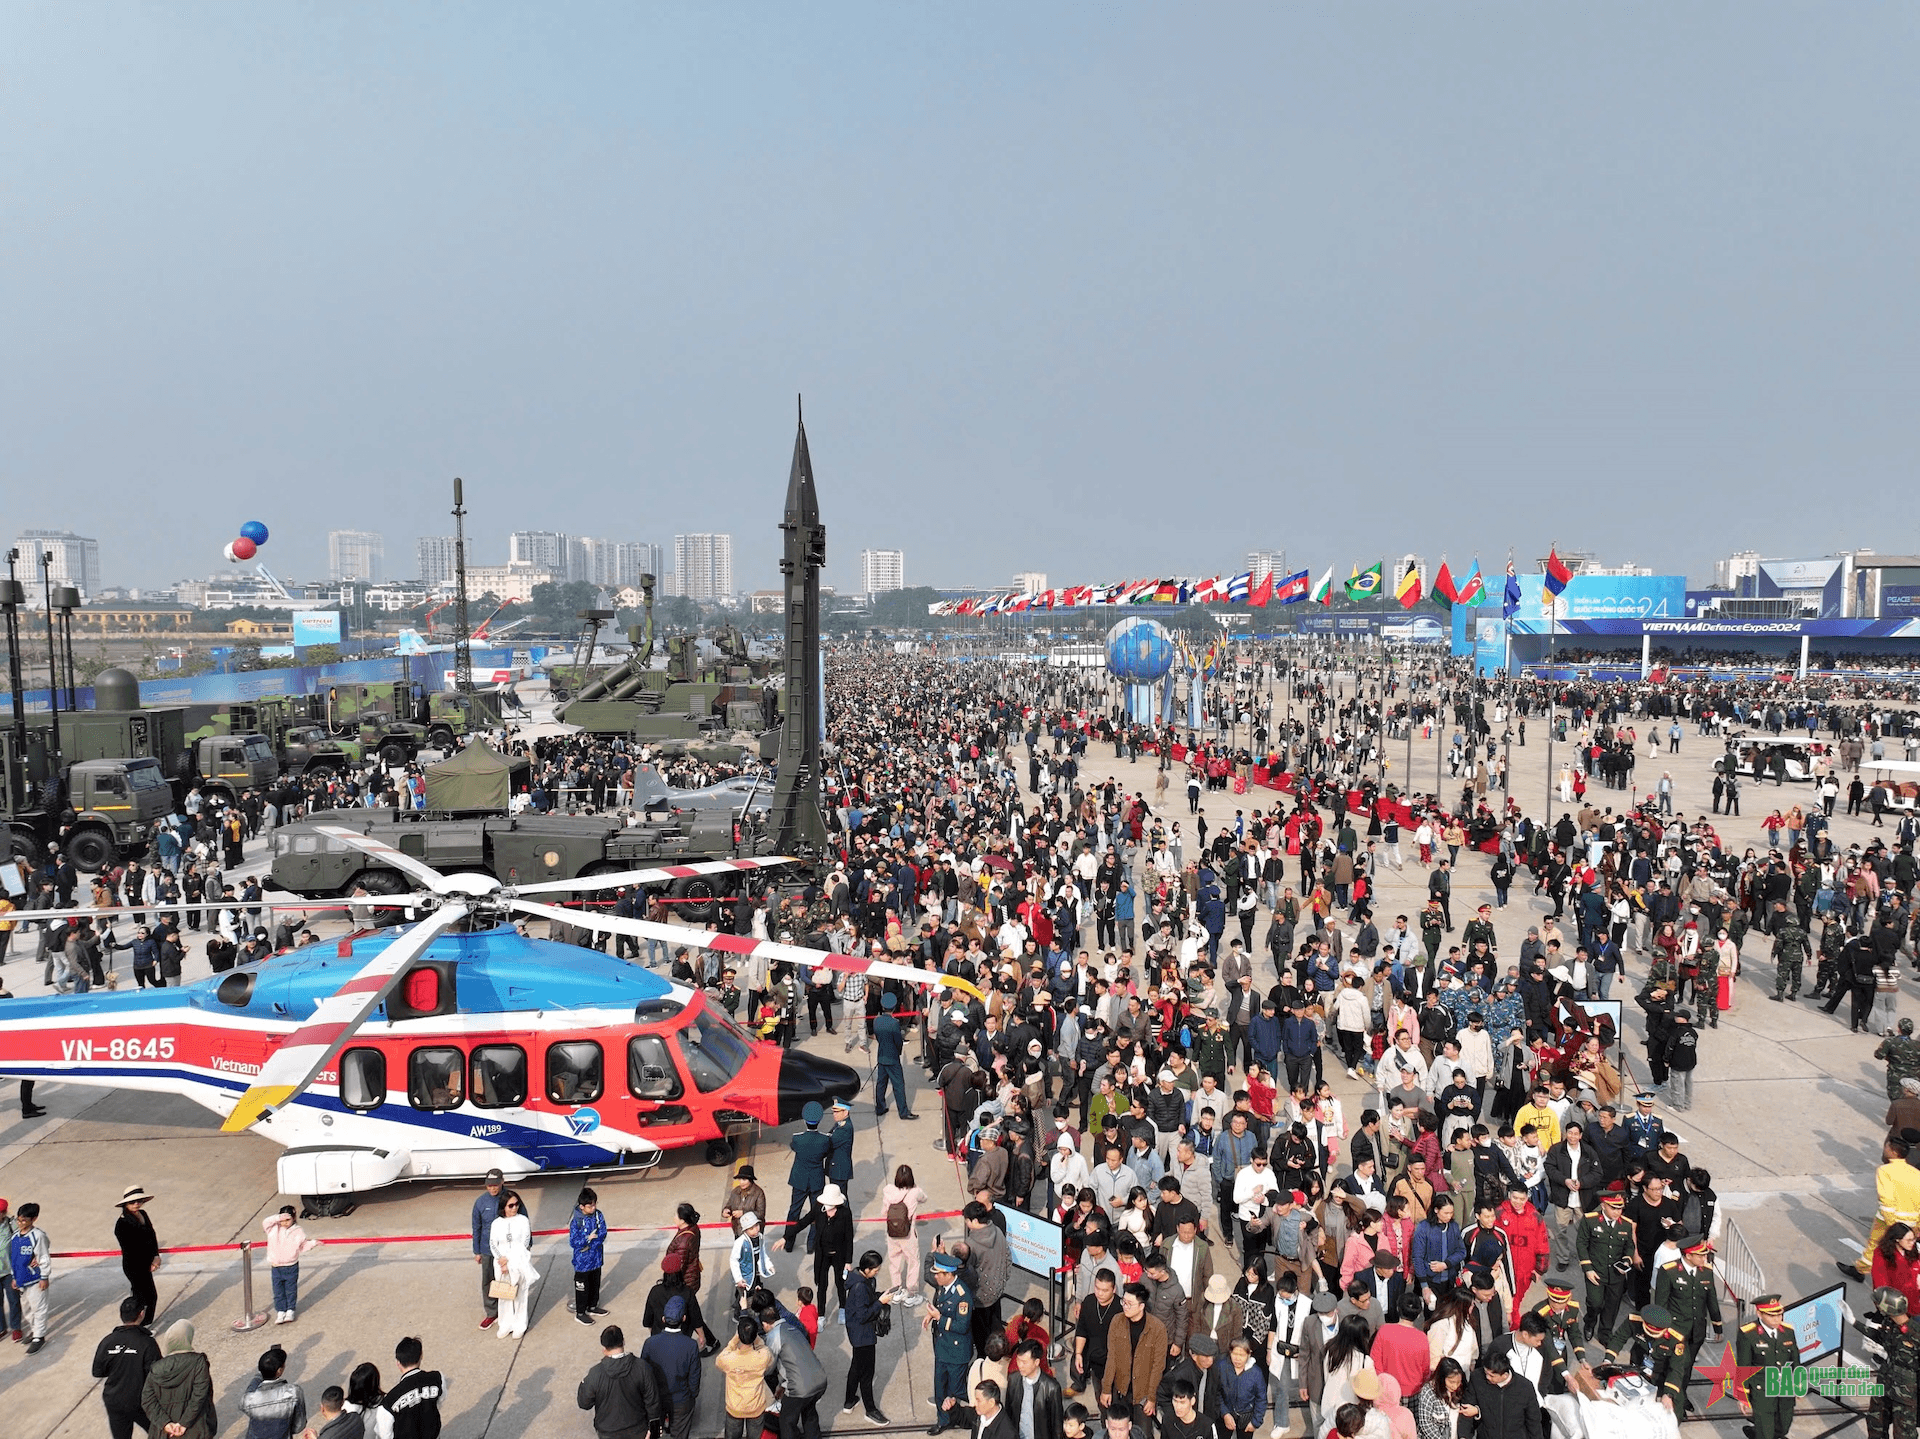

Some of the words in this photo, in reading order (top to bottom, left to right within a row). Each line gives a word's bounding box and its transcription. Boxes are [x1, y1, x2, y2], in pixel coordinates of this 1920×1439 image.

[61, 1037, 175, 1061] VN-8645
[211, 1056, 260, 1074] Vietnam
[1804, 1331, 1817, 1342] EXIT
